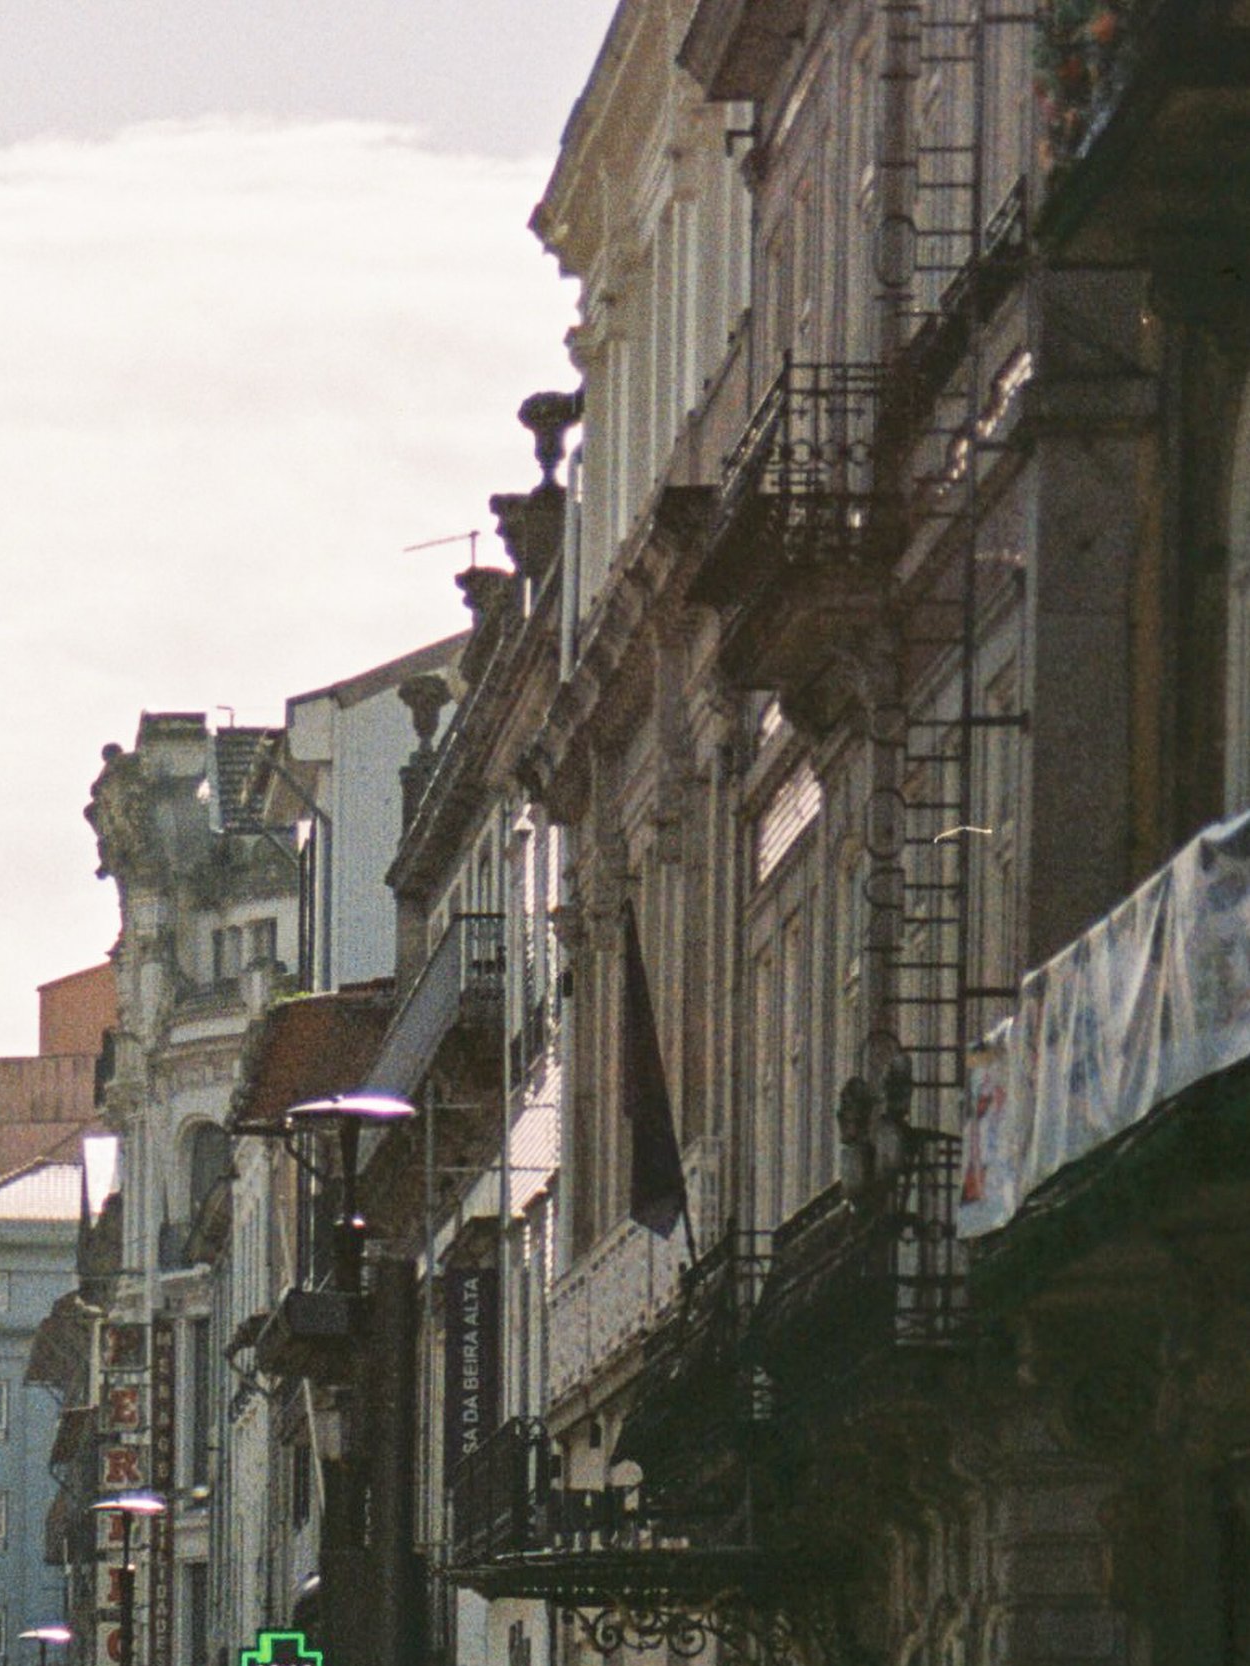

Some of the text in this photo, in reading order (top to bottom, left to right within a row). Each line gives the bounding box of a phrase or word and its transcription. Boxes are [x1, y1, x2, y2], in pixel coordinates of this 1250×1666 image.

[462, 1277, 479, 1327] ALTA
[462, 1330, 479, 1390] BEIRA
[462, 1397, 479, 1424] DA
